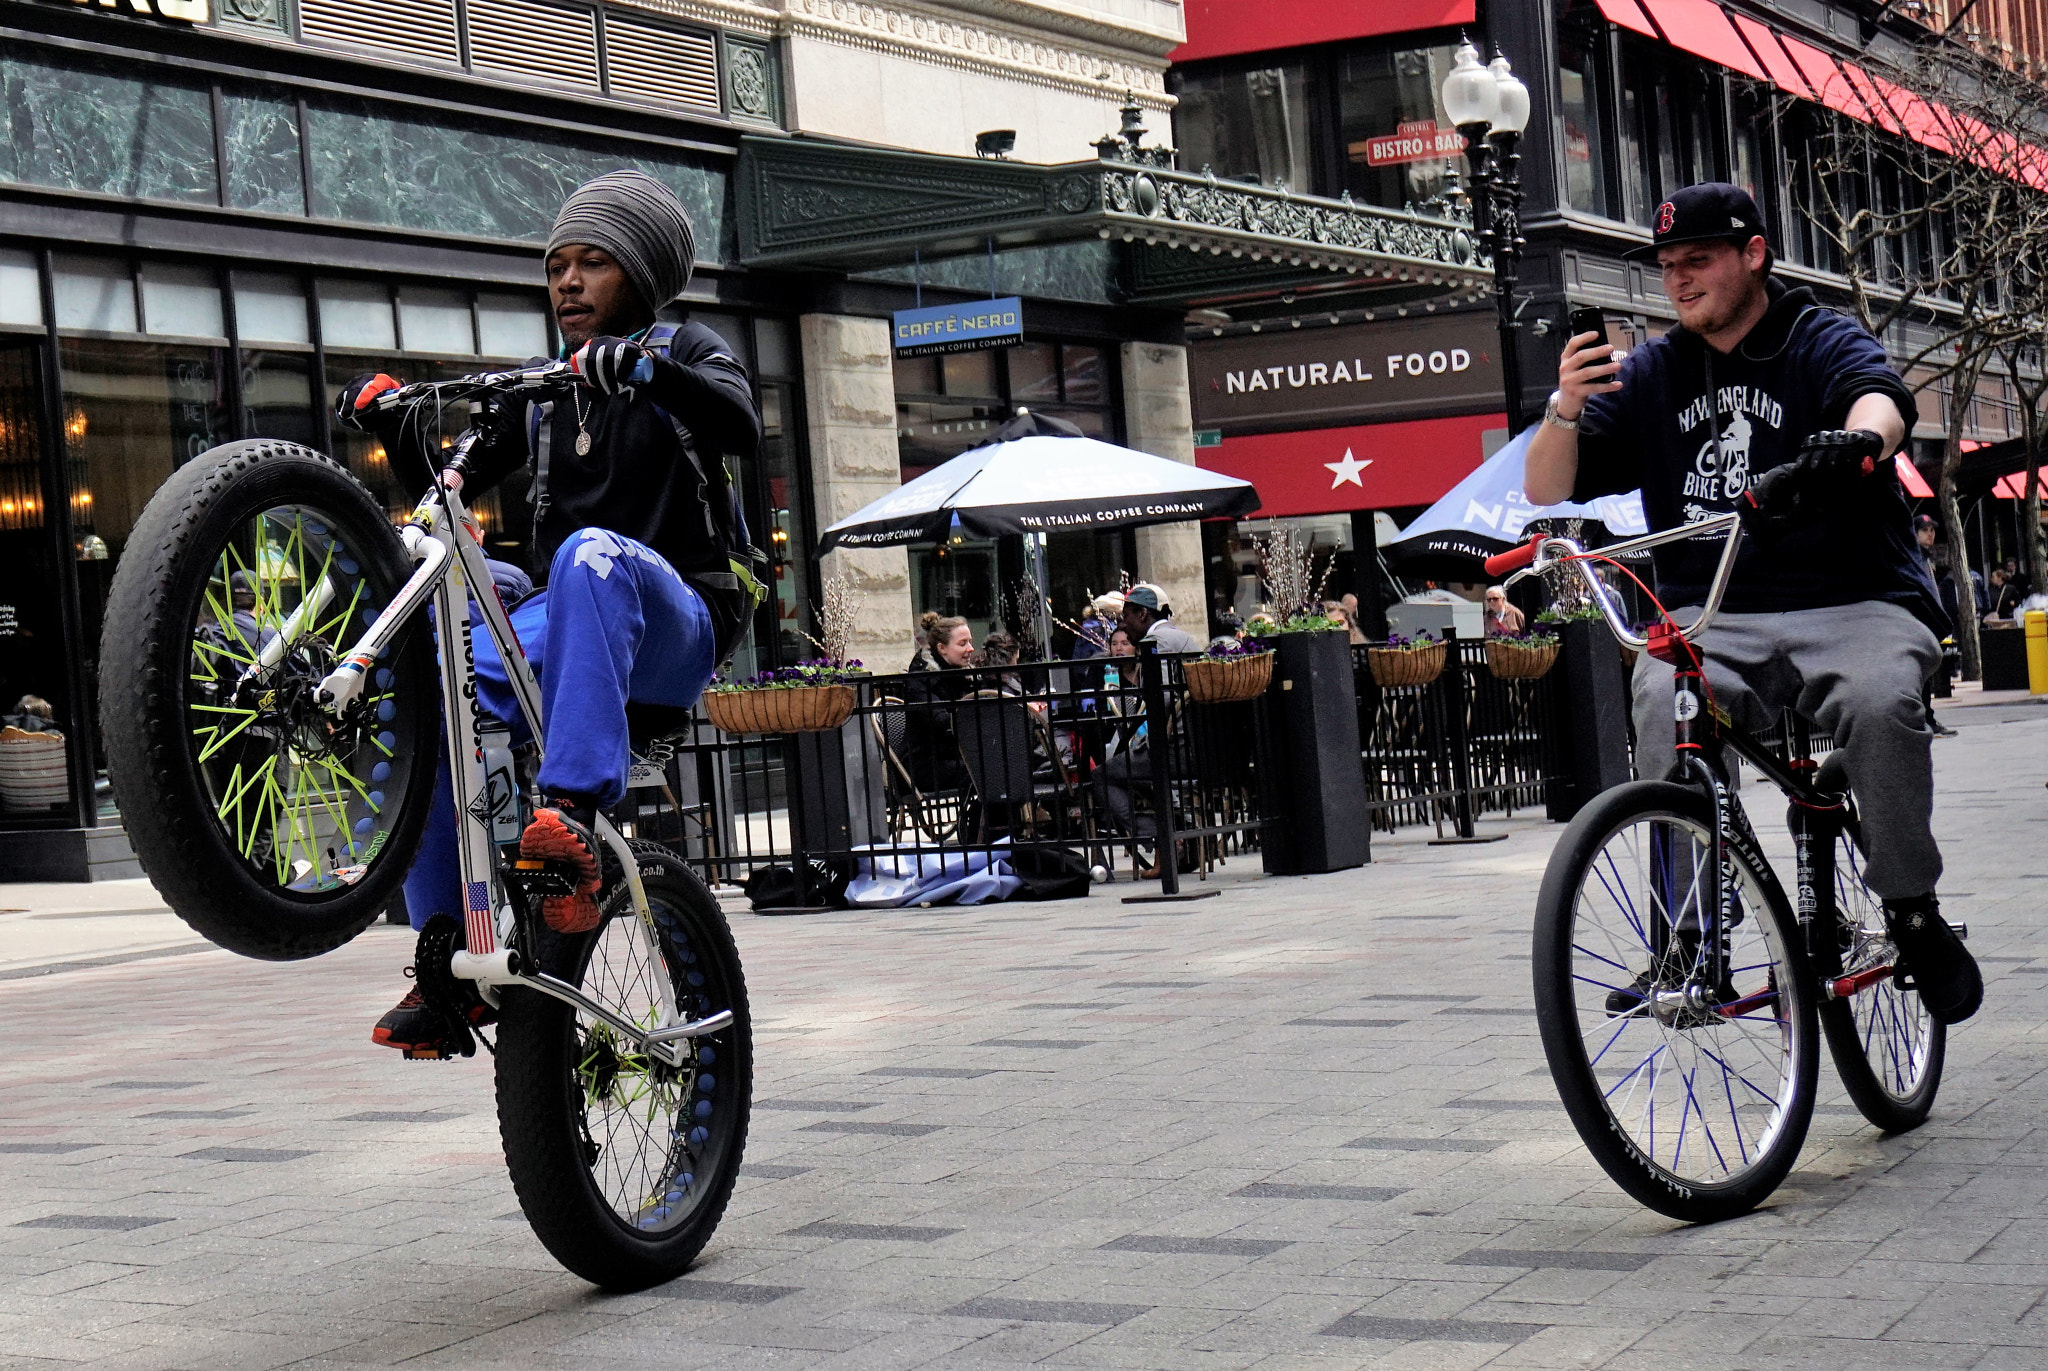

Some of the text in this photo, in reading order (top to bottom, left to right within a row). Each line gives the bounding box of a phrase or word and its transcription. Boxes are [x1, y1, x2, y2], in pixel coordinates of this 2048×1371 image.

[1403, 123, 1429, 133] CENTRAL
[1373, 133, 1464, 160] BISTRO & BAR
[1657, 201, 1676, 235] B
[898, 312, 1016, 338] CAFFÈ NERO
[900, 337, 1018, 357] THE ITALIAN COFFEE COMPANY
[1226, 348, 1471, 395] NATURAL FOOD
[1678, 386, 1783, 434] NEW ENGLAND
[1682, 471, 1720, 501] BIKE
[1020, 502, 1204, 527] THE ITALIAN COFFEE COMPANY
[1428, 541, 1448, 550] THE
